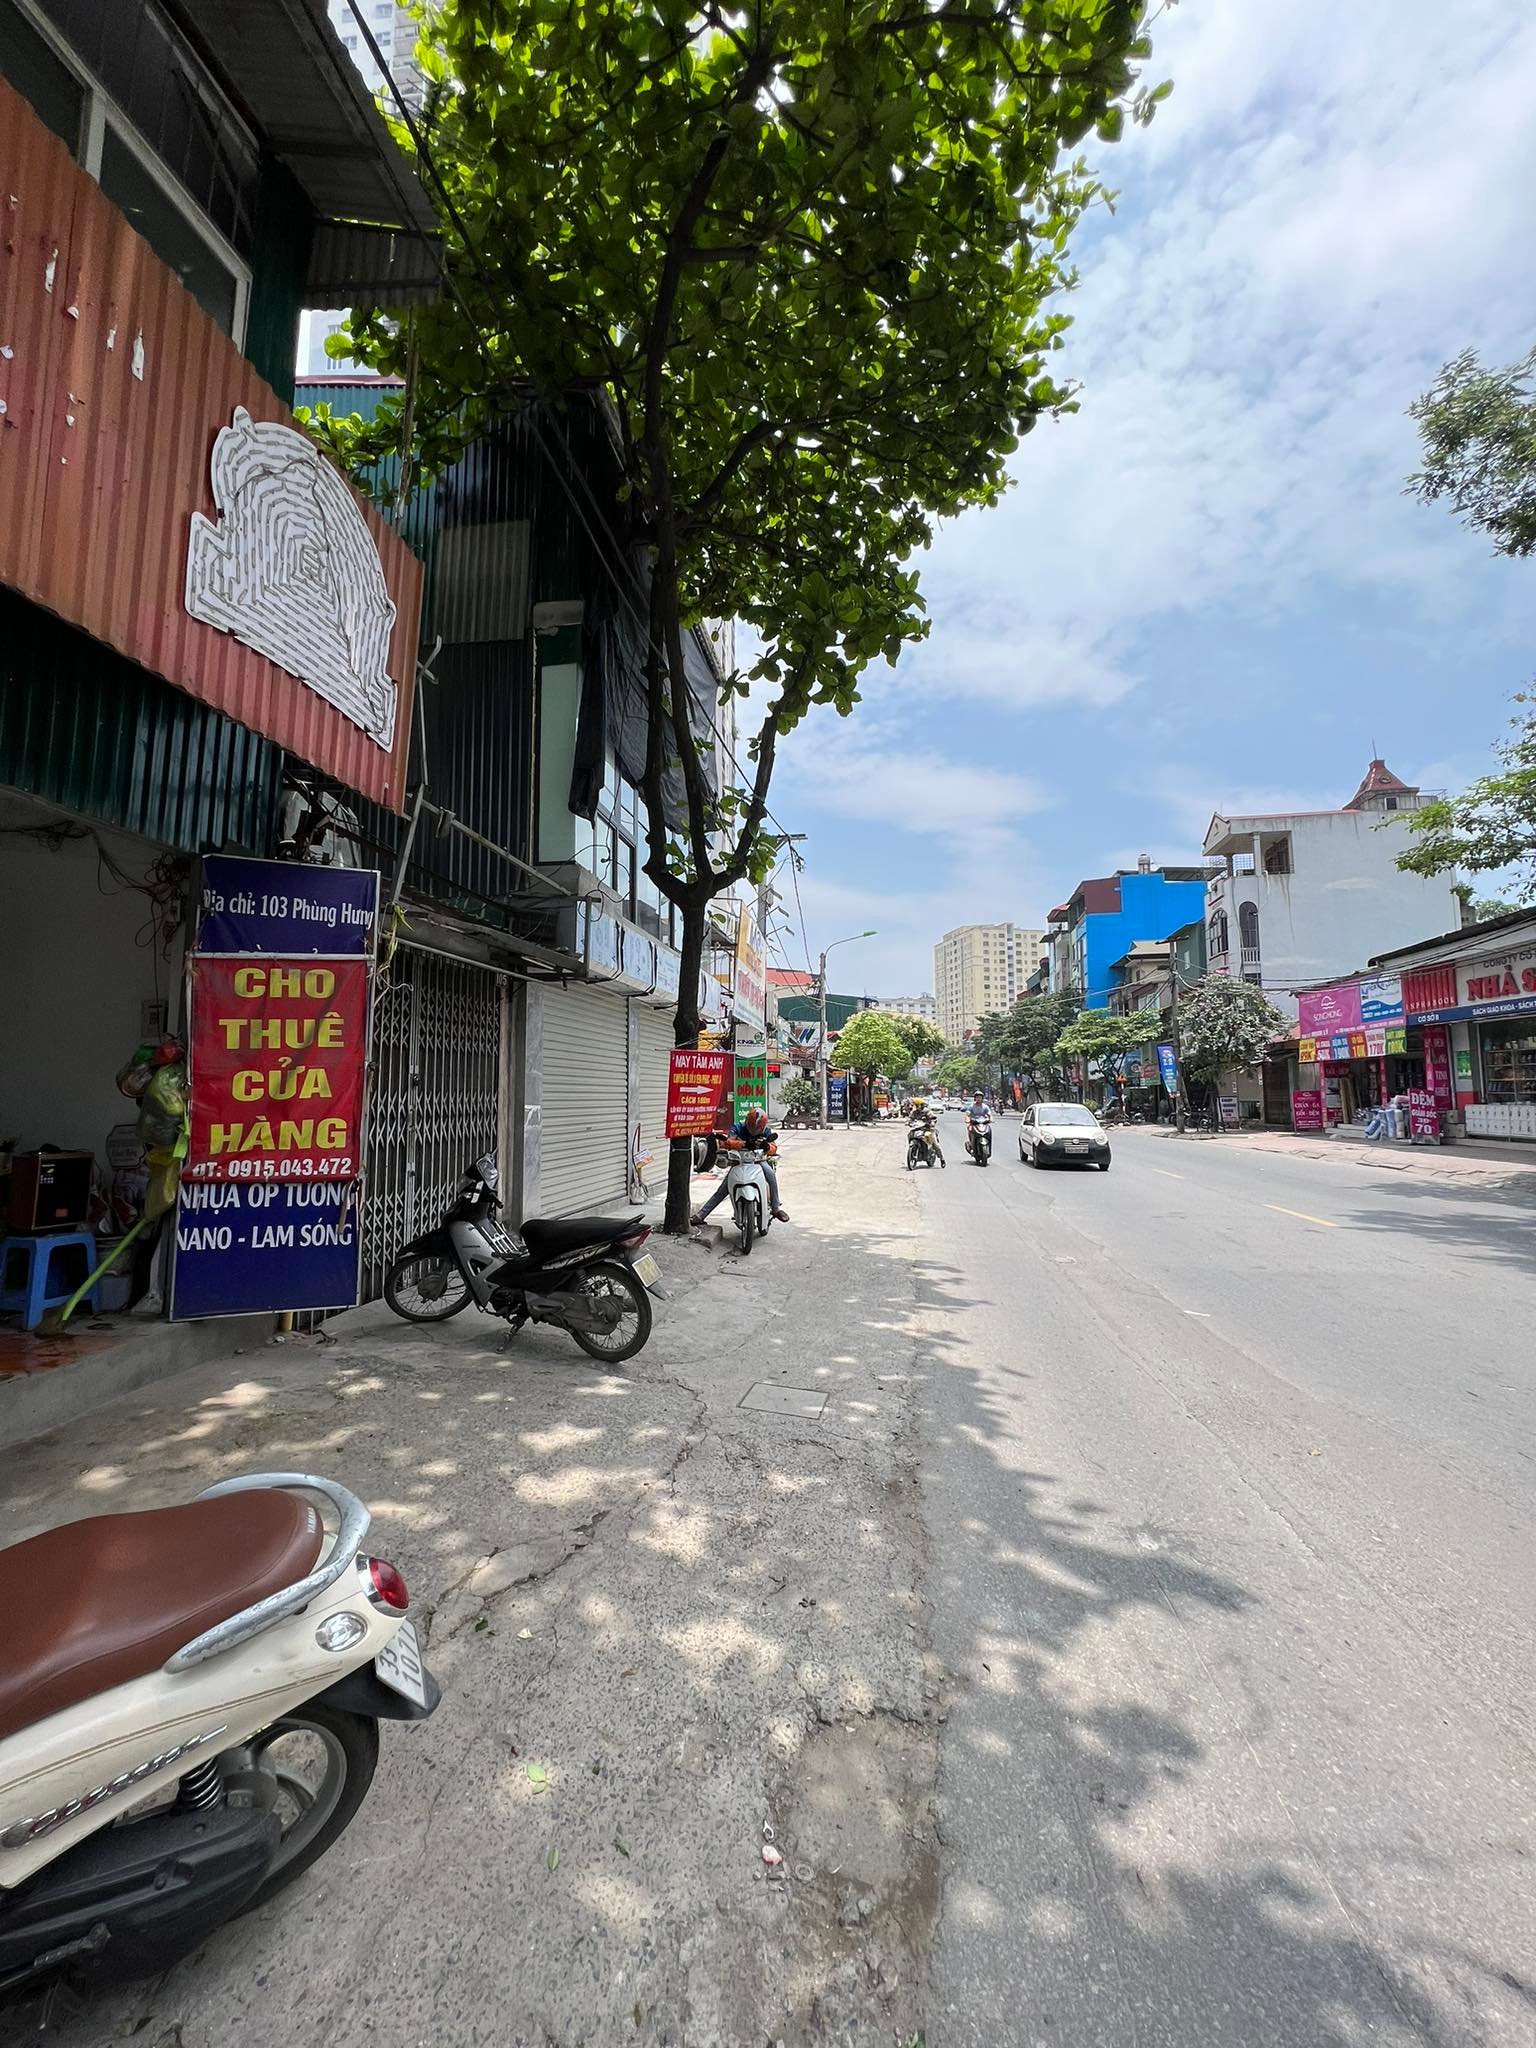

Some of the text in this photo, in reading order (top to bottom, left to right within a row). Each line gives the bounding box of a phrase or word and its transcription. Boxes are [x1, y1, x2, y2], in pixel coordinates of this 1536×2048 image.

[229, 892, 255, 915] chỉ:
[260, 895, 287, 917] 103
[292, 898, 336, 927] Phùng
[233, 967, 336, 999] CHO
[218, 1011, 345, 1050] THUÊ
[232, 1056, 333, 1102] CỬA
[1411, 1091, 1435, 1108] ĐỆM
[210, 1115, 347, 1155] HÀNG
[228, 1157, 352, 1178] 0915.043.472
[178, 1227, 232, 1251] NANO
[252, 1225, 294, 1248] LAM
[299, 1217, 352, 1247] SÓNG
